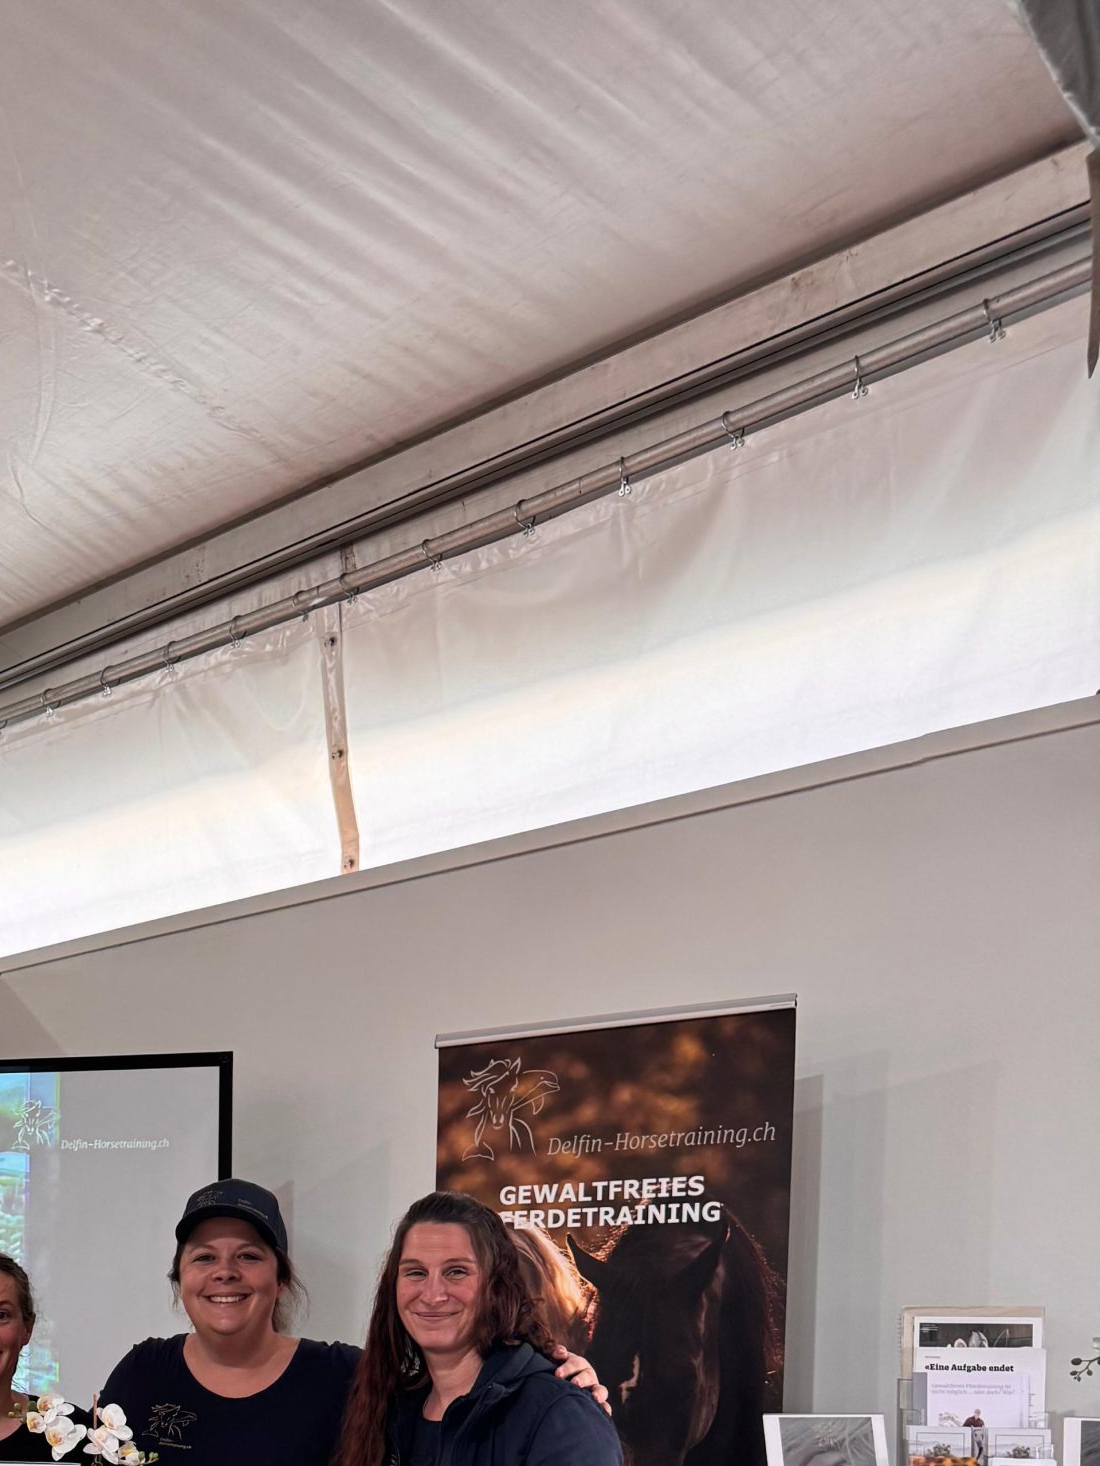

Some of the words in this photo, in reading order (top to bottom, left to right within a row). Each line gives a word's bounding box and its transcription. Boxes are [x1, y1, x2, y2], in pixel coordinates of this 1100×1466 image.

[60, 1137, 170, 1151] Delfin-Horsetraining.ch
[546, 1121, 777, 1159] Delfin-Horsetraining.ch
[500, 1175, 705, 1206] GEWALTFREIES
[951, 1363, 987, 1373] Aufgabe
[988, 1363, 1014, 1372] endet
